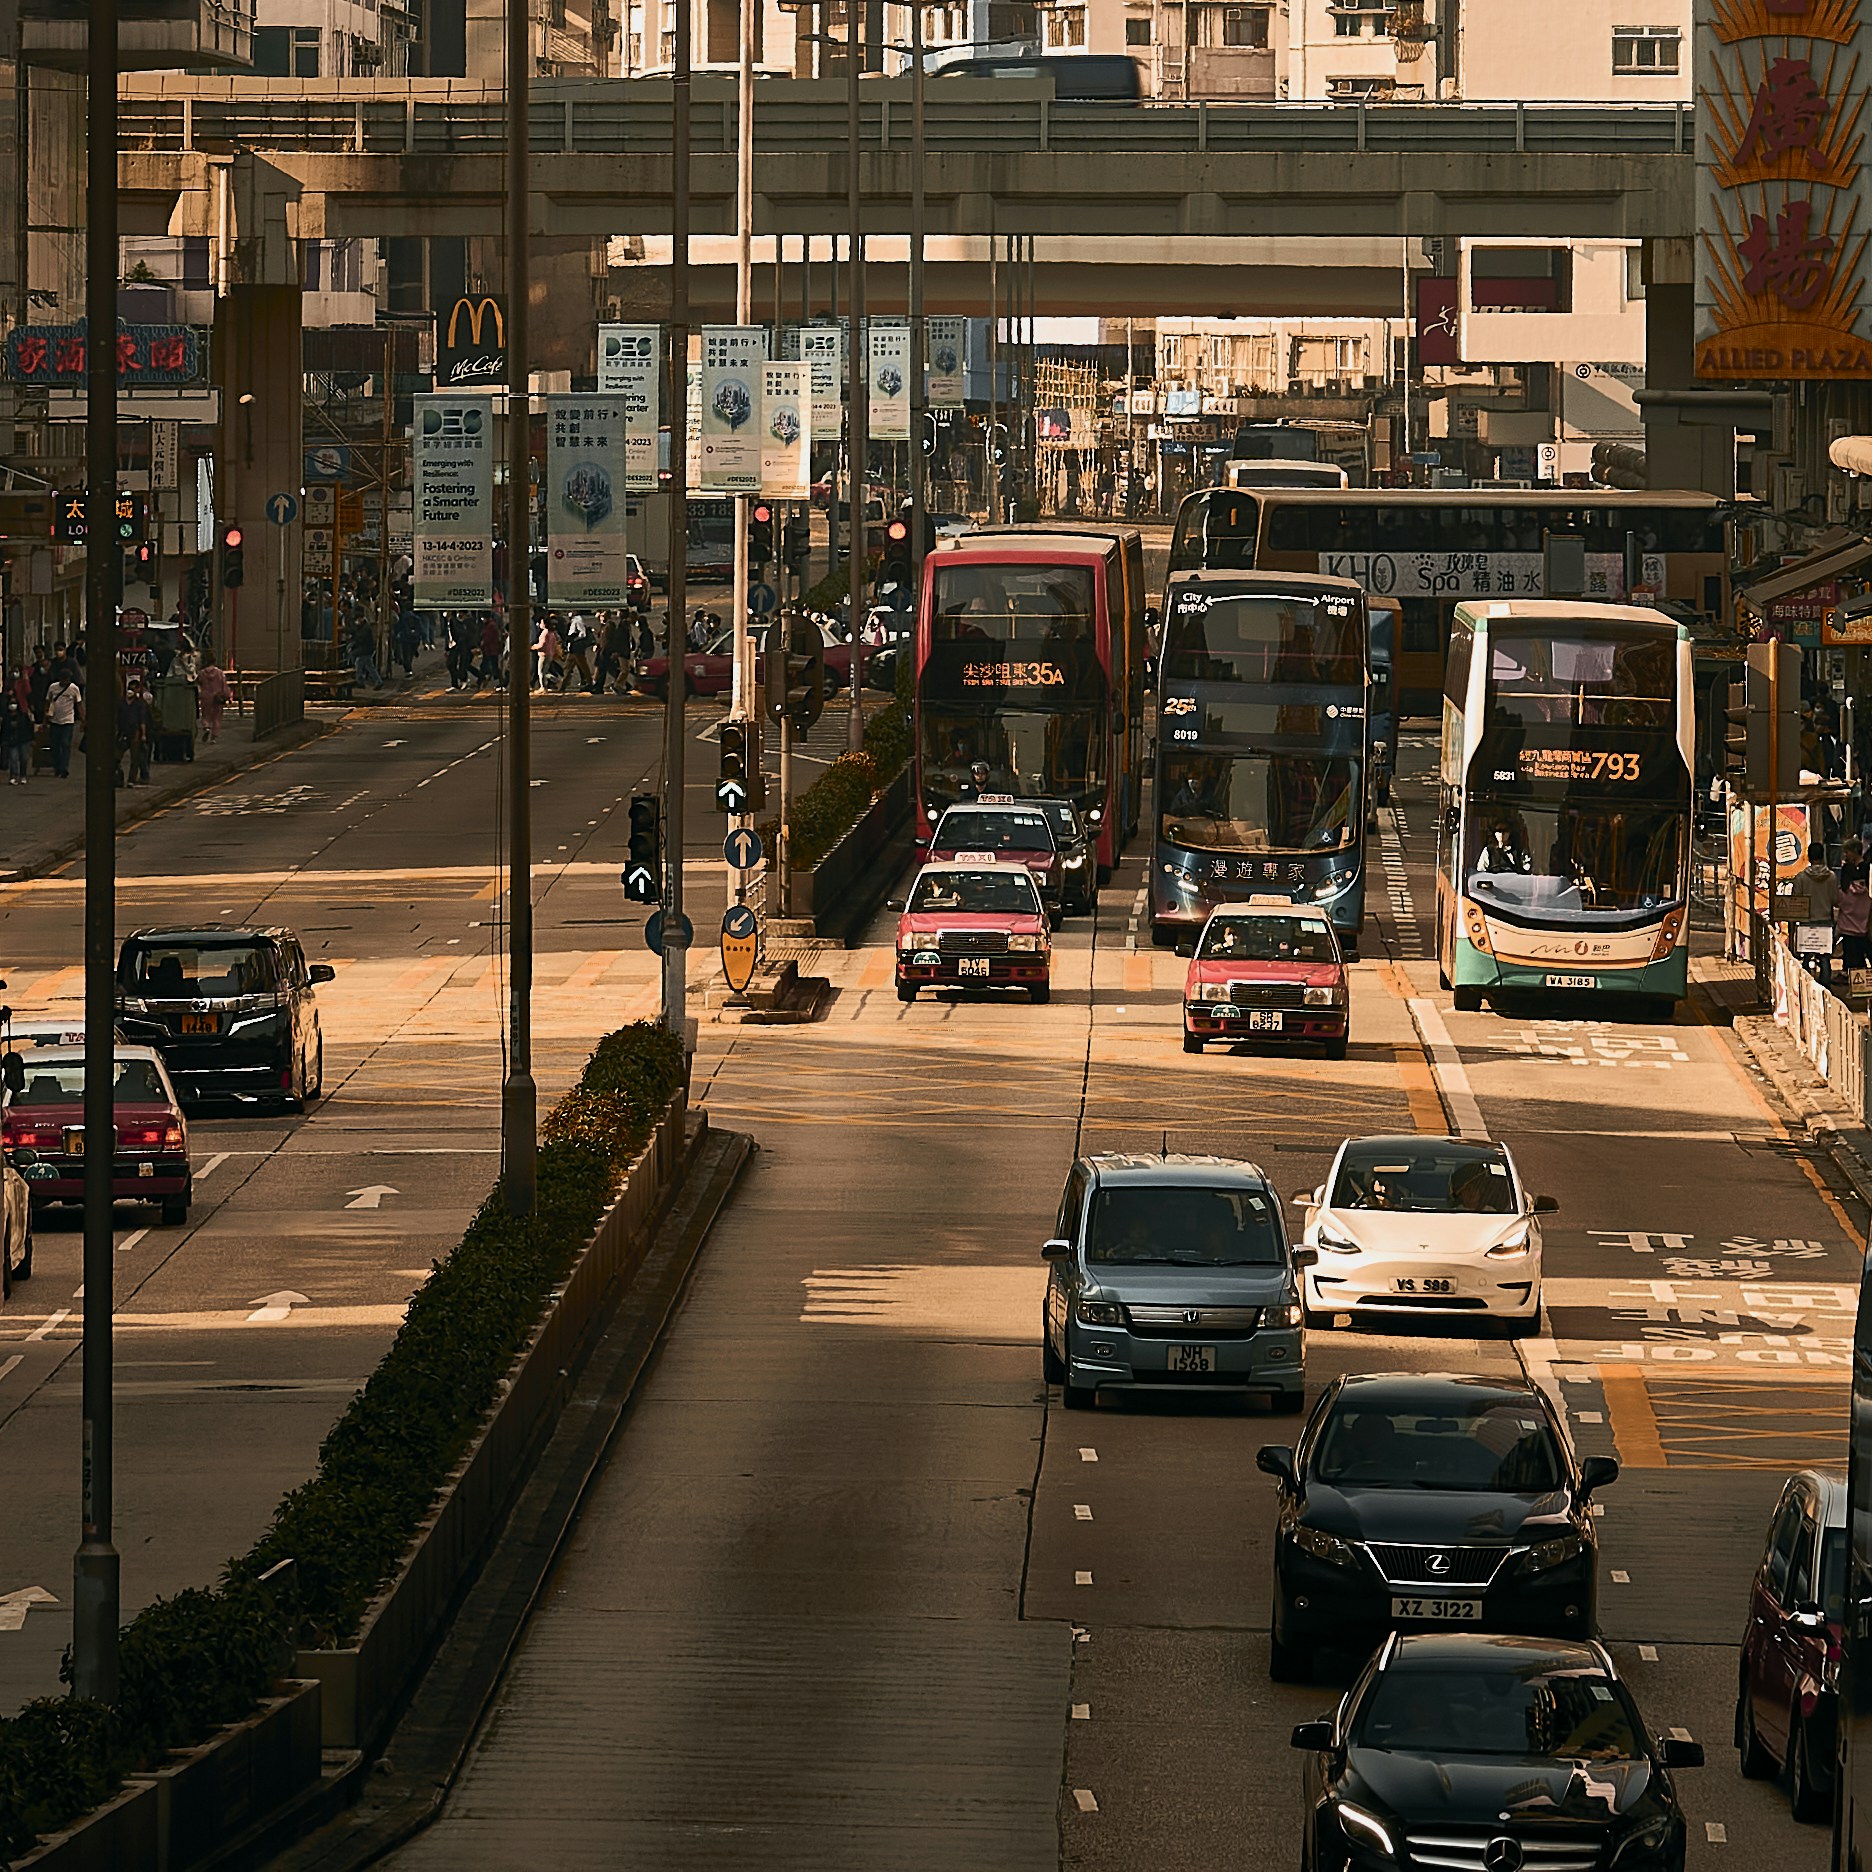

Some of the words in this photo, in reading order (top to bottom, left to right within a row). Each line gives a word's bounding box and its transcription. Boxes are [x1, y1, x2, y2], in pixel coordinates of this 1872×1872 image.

[606, 337, 651, 356] DES
[451, 355, 503, 380] McCafé
[1702, 350, 1783, 372] ALLIED
[1791, 350, 1870, 372] PLAZA
[556, 409, 608, 420] 蛻變前行
[423, 409, 482, 435] DES
[556, 423, 580, 433] 共創
[556, 437, 608, 447] 智慧未來
[423, 460, 456, 468] Emerging
[423, 483, 475, 496] Fostering
[423, 499, 431, 507] a
[433, 497, 479, 507] Smarter
[423, 510, 460, 520] Future
[1418, 567, 1460, 595] Spa
[1183, 593, 1203, 603] City
[1321, 594, 1355, 606] Airport
[121, 653, 148, 664] N74
[1027, 662, 1065, 685] 35A
[1174, 730, 1198, 740] 8019
[1591, 753, 1640, 781] 793
[979, 794, 1013, 804] TAXI
[1210, 858, 1306, 881] 漫遊專家
[1550, 977, 1562, 986] WA
[1567, 977, 1590, 987] 3185
[1179, 1346, 1203, 1361] NH
[1171, 1359, 1214, 1373] 1568
[1398, 1599, 1425, 1618] XZ
[1431, 1599, 1476, 1618] 3122
